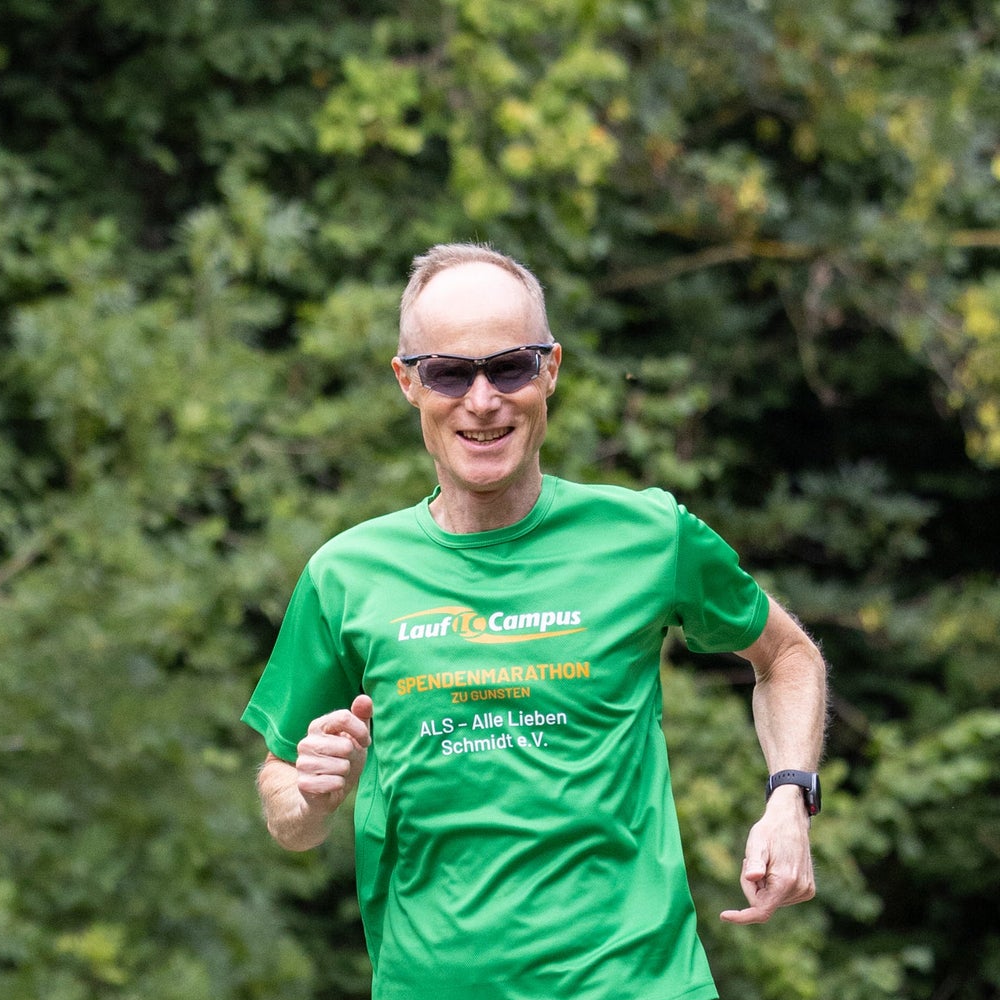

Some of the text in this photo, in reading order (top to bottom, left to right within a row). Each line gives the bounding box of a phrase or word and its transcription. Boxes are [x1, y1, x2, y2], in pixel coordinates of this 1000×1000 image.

[398, 616, 453, 641] Lauf
[488, 610, 581, 632] Campus
[397, 662, 590, 696] SPENDENMARATHON
[451, 687, 531, 704] ZU GUNSTEN
[420, 718, 454, 737] ALS
[472, 713, 504, 731] Alle
[508, 710, 567, 727] Lieben
[441, 731, 548, 756] Schmidt e.V.
